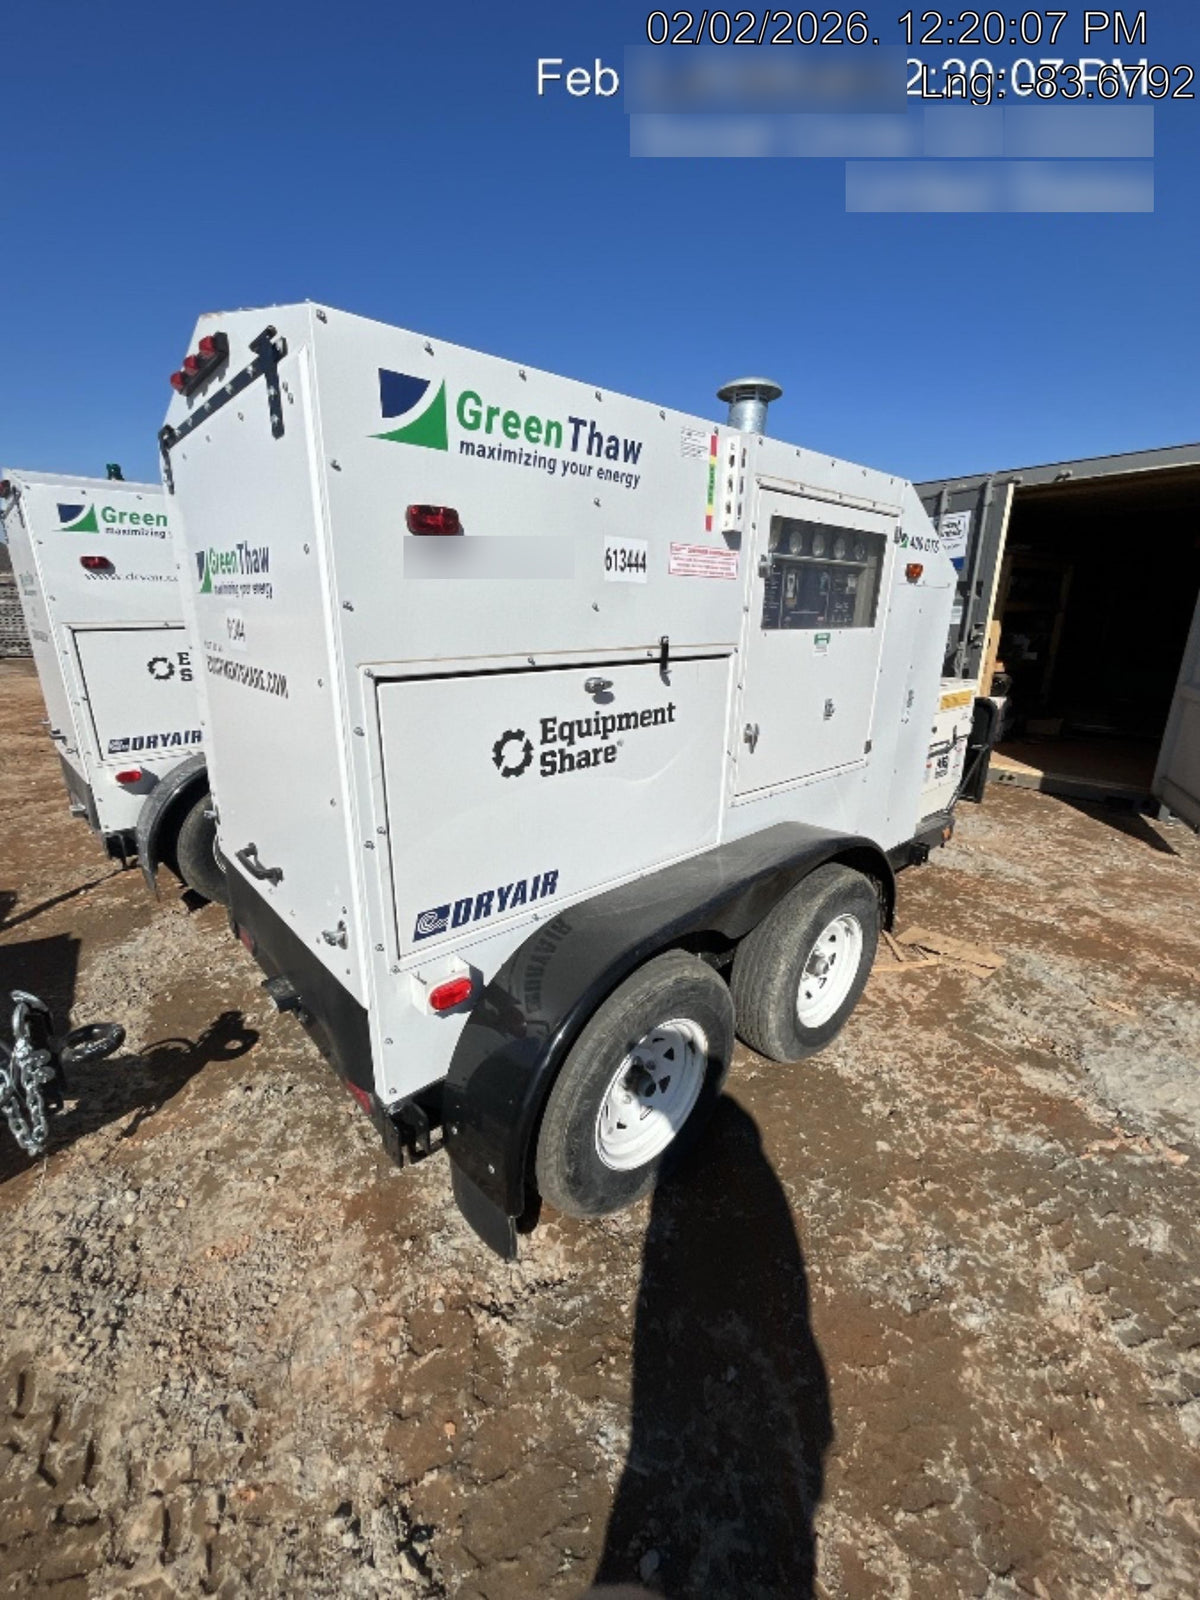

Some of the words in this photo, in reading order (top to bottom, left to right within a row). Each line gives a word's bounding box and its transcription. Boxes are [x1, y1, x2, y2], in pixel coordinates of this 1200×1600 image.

[459, 439, 557, 476] maximizing
[561, 459, 593, 480] your
[596, 466, 641, 490] energy
[604, 546, 648, 575] 613444
[132, 729, 203, 752] DRYAIR
[540, 702, 676, 746] Equipment
[451, 869, 559, 929] DRYAIR
